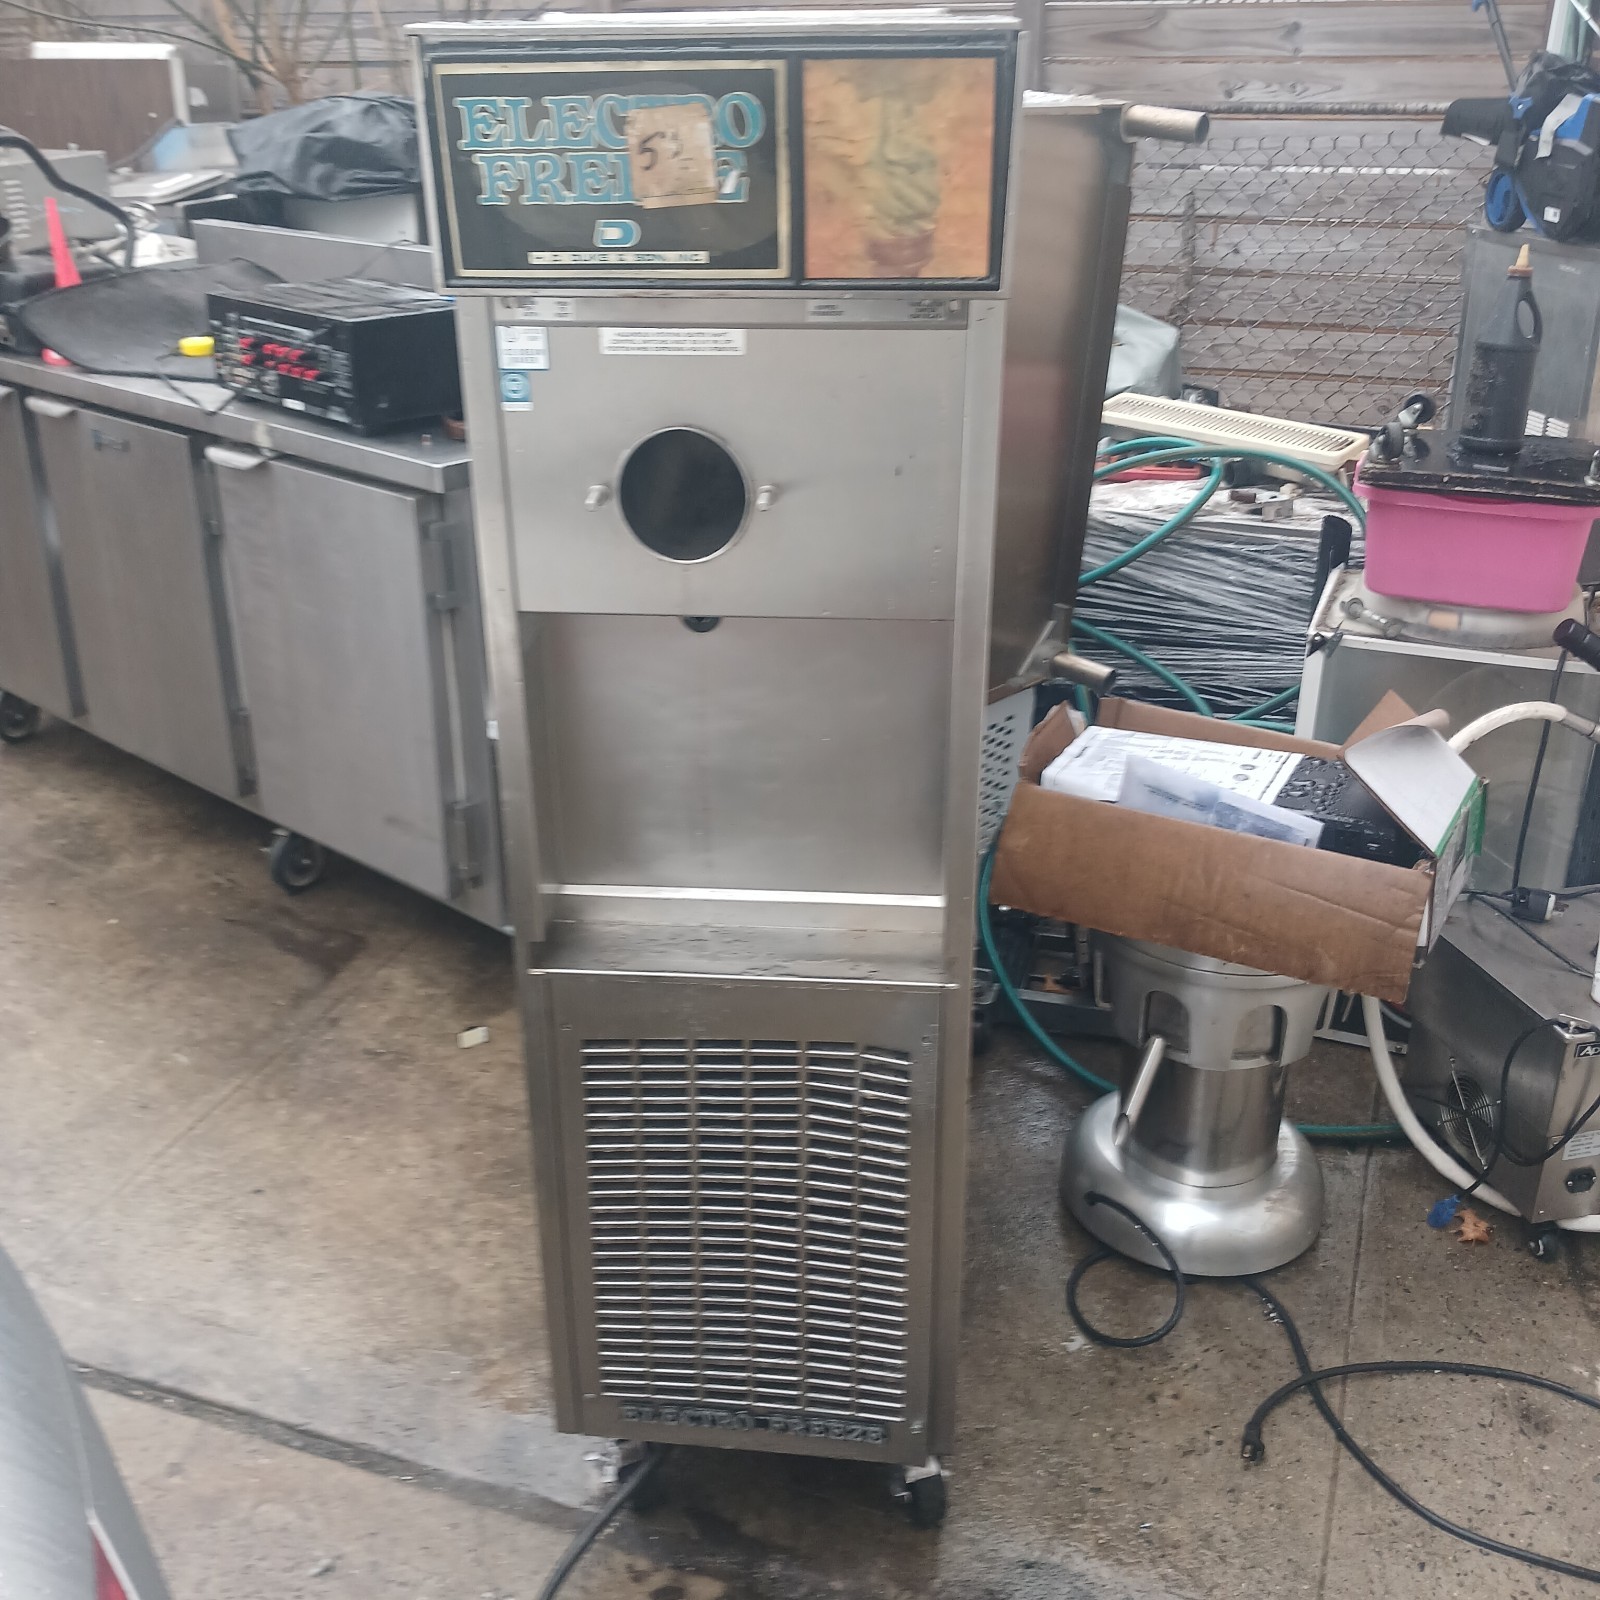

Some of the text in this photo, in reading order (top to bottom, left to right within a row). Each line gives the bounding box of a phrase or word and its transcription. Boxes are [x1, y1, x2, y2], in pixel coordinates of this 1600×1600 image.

[453, 91, 766, 150] ELECO
[619, 1404, 885, 1444] ELECTRO FREEZE
